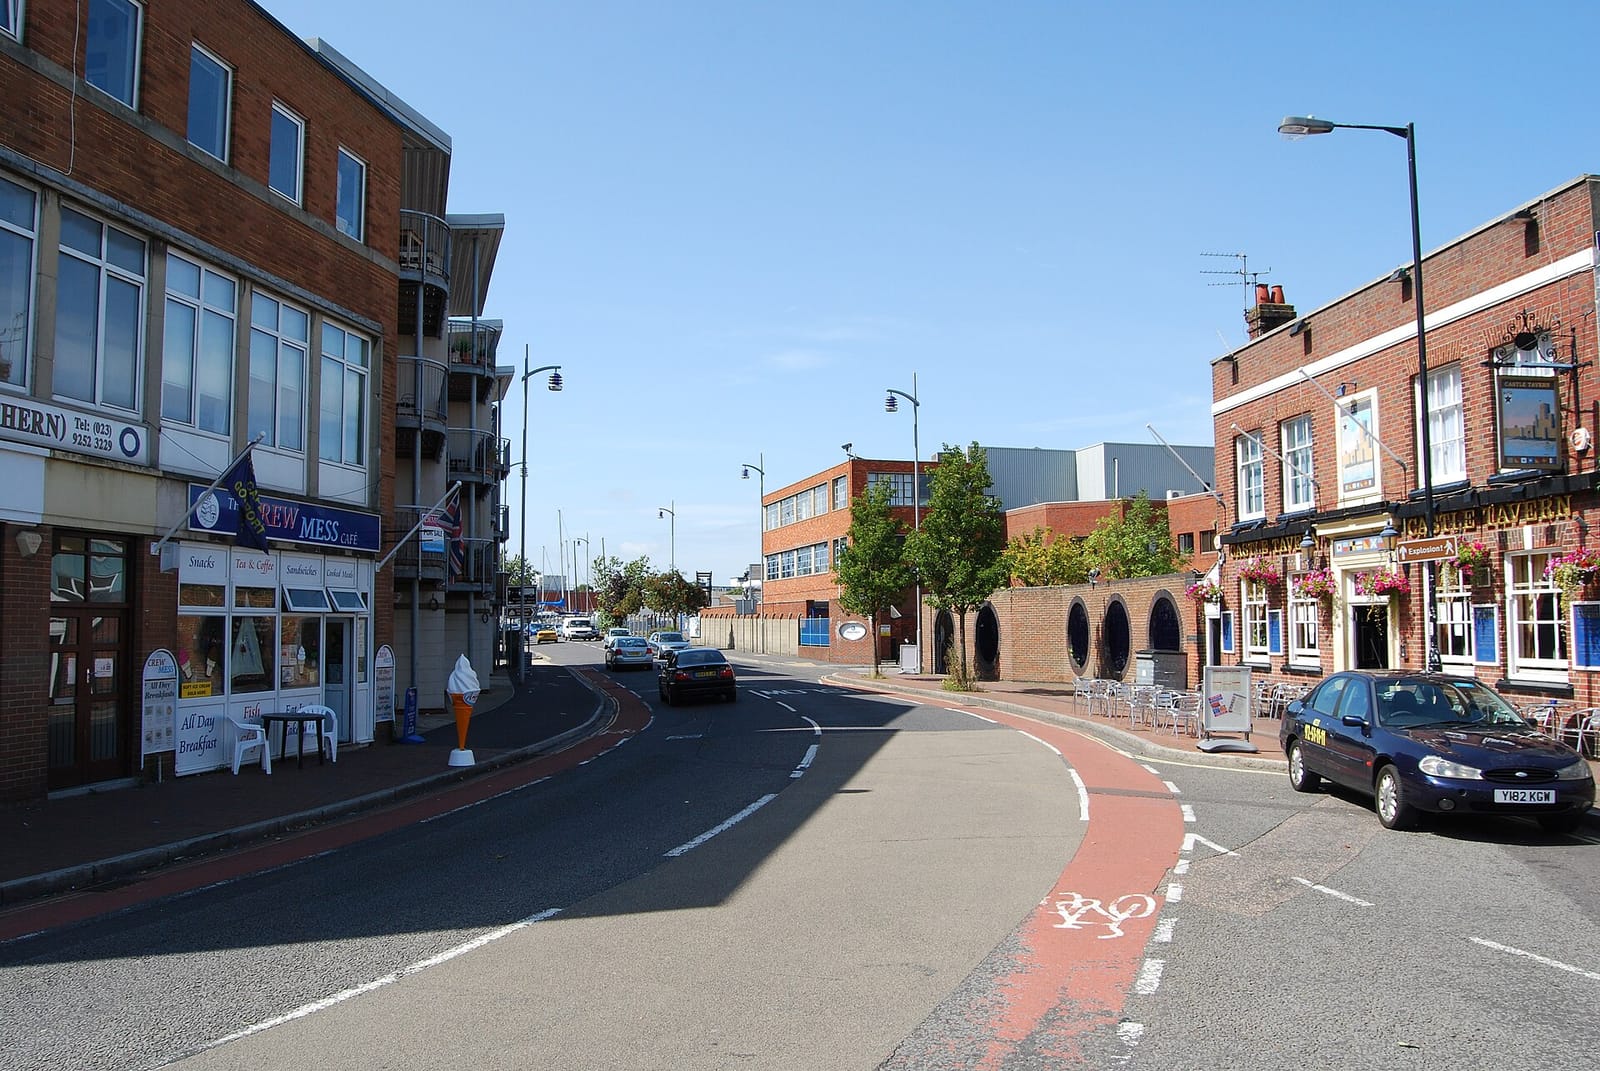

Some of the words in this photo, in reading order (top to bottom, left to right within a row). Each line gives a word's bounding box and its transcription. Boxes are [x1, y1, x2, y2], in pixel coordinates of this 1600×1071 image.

[74, 417, 90, 432] Tel:
[93, 422, 112, 439] (023)
[73, 433, 91, 448] 9252
[94, 438, 113, 451] 3229
[1482, 494, 1573, 525] TAVERN
[299, 517, 340, 541] MESS
[340, 531, 358, 545] CAFÉ
[1230, 539, 1268, 558] CASTLE
[1409, 544, 1444, 556] Explosion!
[189, 555, 216, 569] Snacks
[236, 558, 246, 569] Tea
[249, 559, 255, 569] &
[256, 559, 274, 575] Coffee
[286, 564, 318, 577] Sandwiches
[147, 658, 165, 667] CREW
[244, 702, 260, 720] Fish
[181, 713, 197, 730] All
[198, 715, 215, 732] Day
[179, 735, 217, 757] Breakfast
[1502, 791, 1527, 801] Y182
